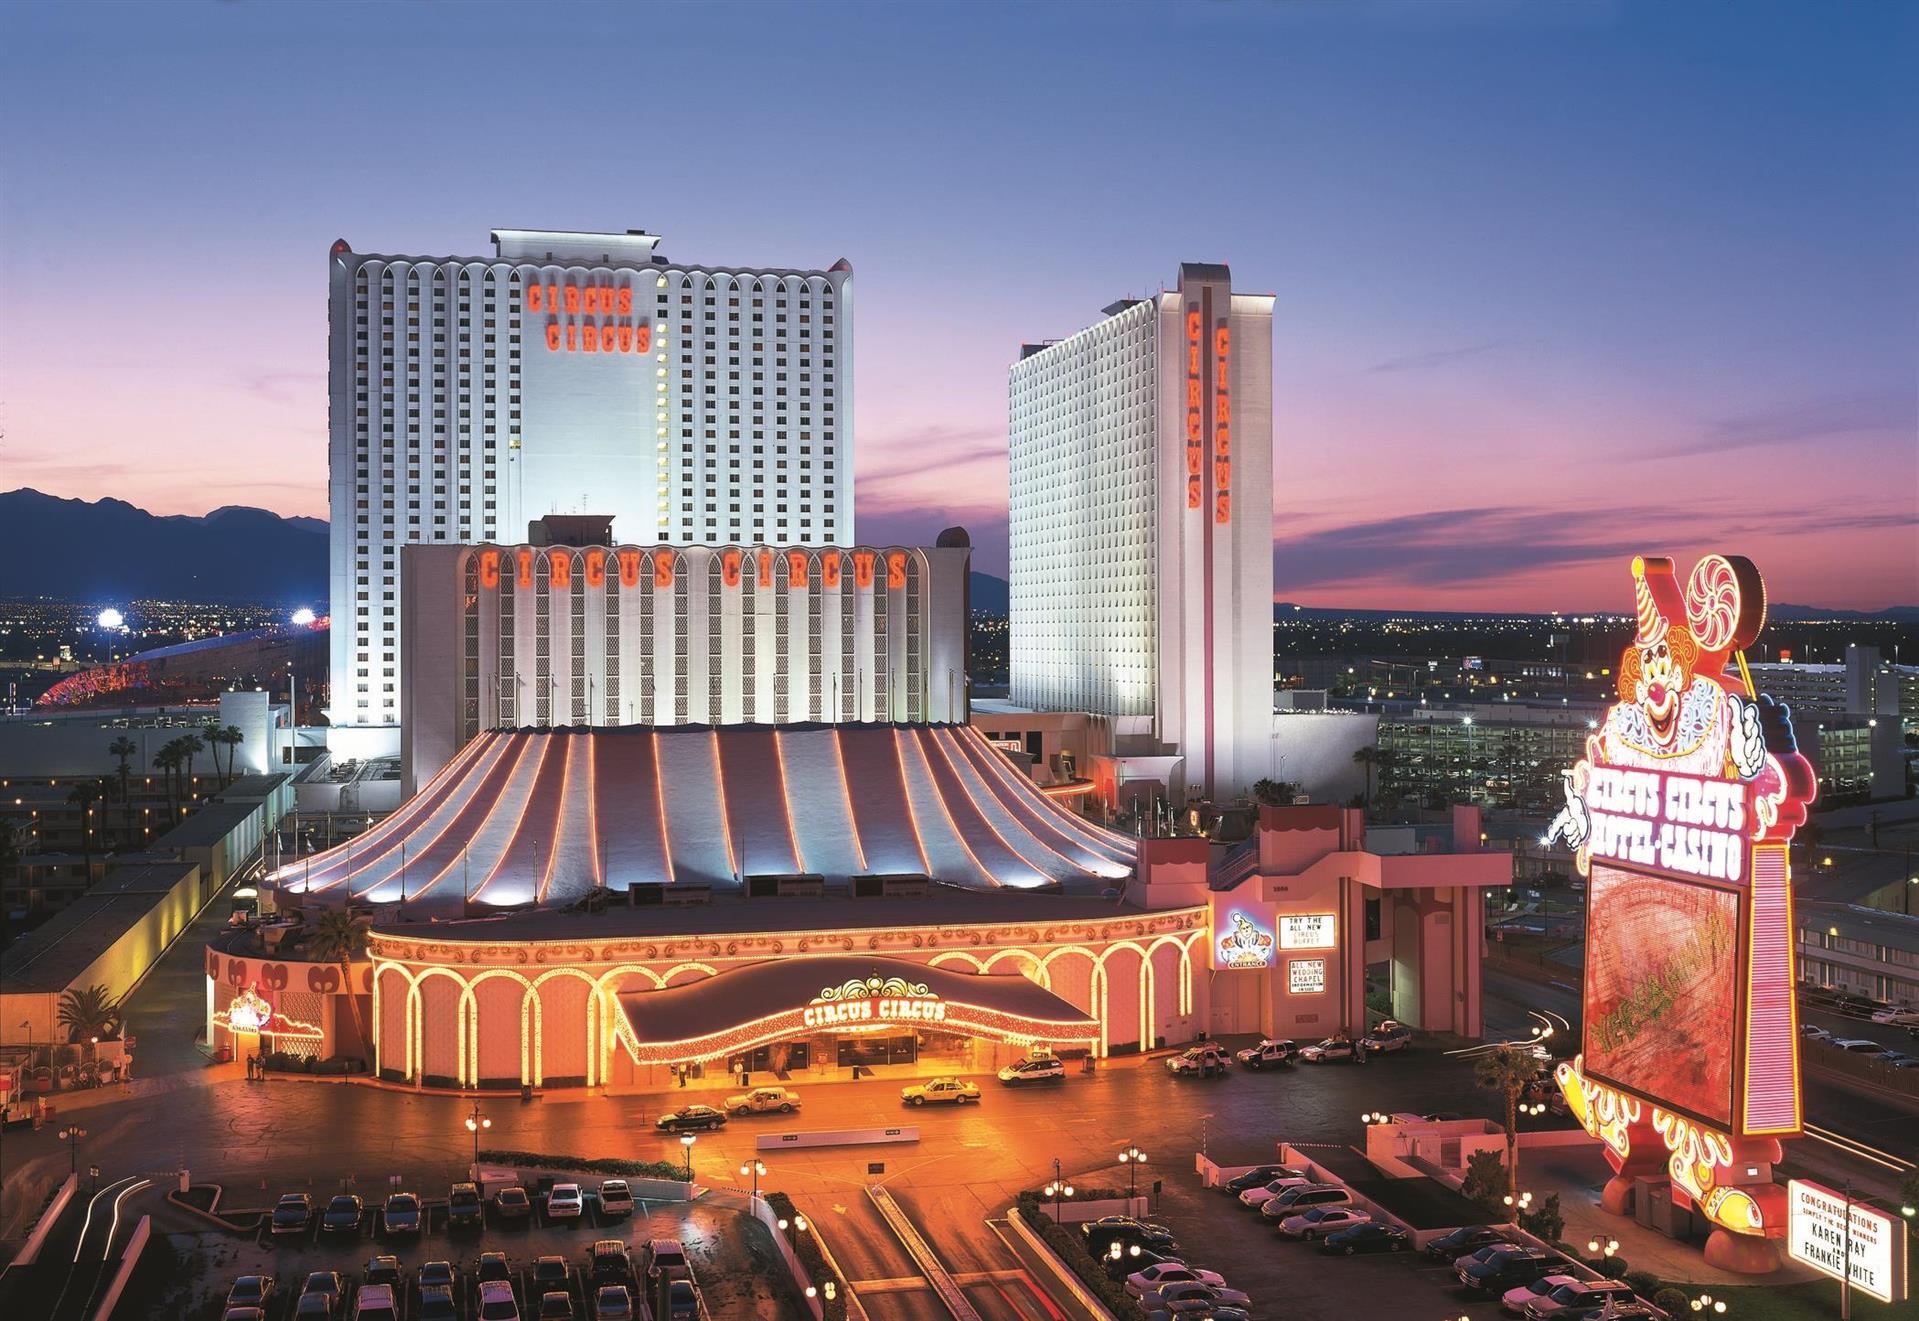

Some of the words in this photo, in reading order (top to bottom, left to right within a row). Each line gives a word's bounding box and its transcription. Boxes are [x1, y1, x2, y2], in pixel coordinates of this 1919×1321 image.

[528, 284, 632, 315] CIRCUS
[546, 324, 650, 353] CIRCUS
[1187, 312, 1202, 508] CIRCUS
[1216, 327, 1231, 524] CIRCUS
[480, 552, 672, 588] CIRCUS
[723, 552, 906, 589] CIRCUS
[1589, 766, 1660, 818] CIRCUS
[1665, 776, 1745, 831] CIRCUS
[803, 1001, 872, 1026] CIRCUS
[879, 999, 945, 1020] CIRCUS
[1801, 1192, 1878, 1233] CONGRATULATIONS
[1812, 1222, 1841, 1248] KAREN
[1824, 1216, 1834, 1225] THE
[1853, 1229, 1877, 1244] WINNERS
[1804, 1241, 1841, 1270] FRANKIE
[1832, 1247, 1845, 1258] AND
